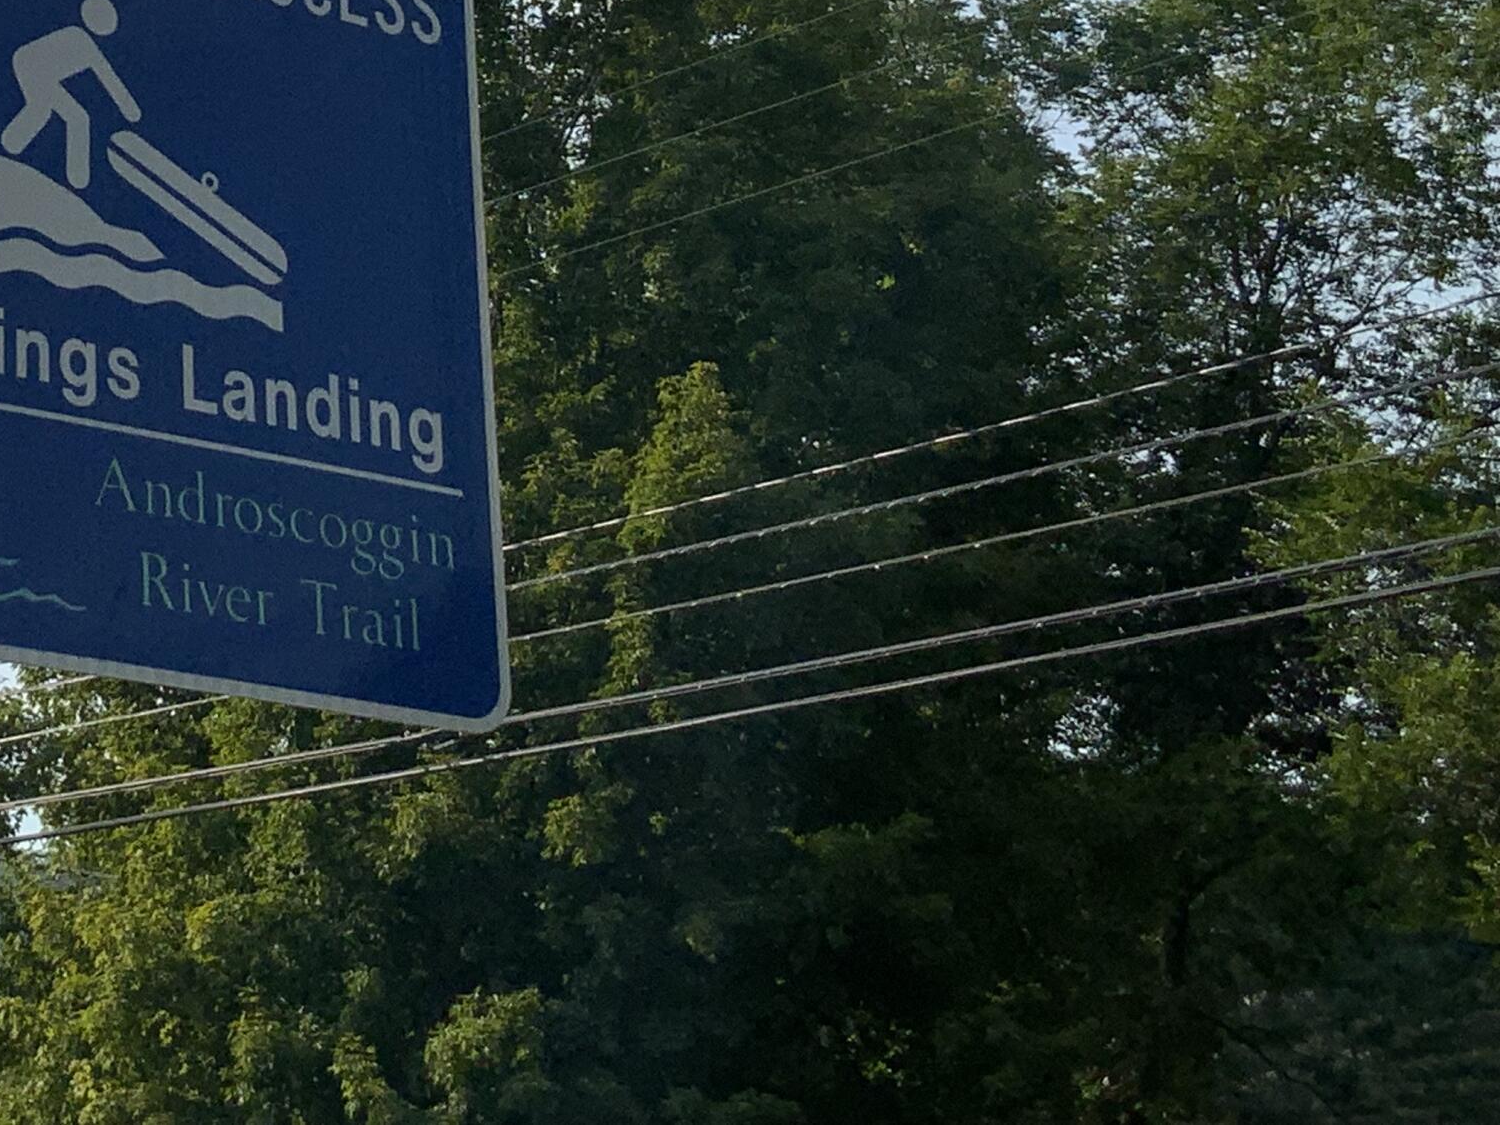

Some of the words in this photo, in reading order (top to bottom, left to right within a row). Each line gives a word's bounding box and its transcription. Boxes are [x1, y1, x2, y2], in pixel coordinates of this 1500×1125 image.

[182, 344, 444, 474] Landing
[95, 458, 454, 579] Androscoggin
[140, 553, 272, 626] River
[300, 579, 420, 651] Trail
